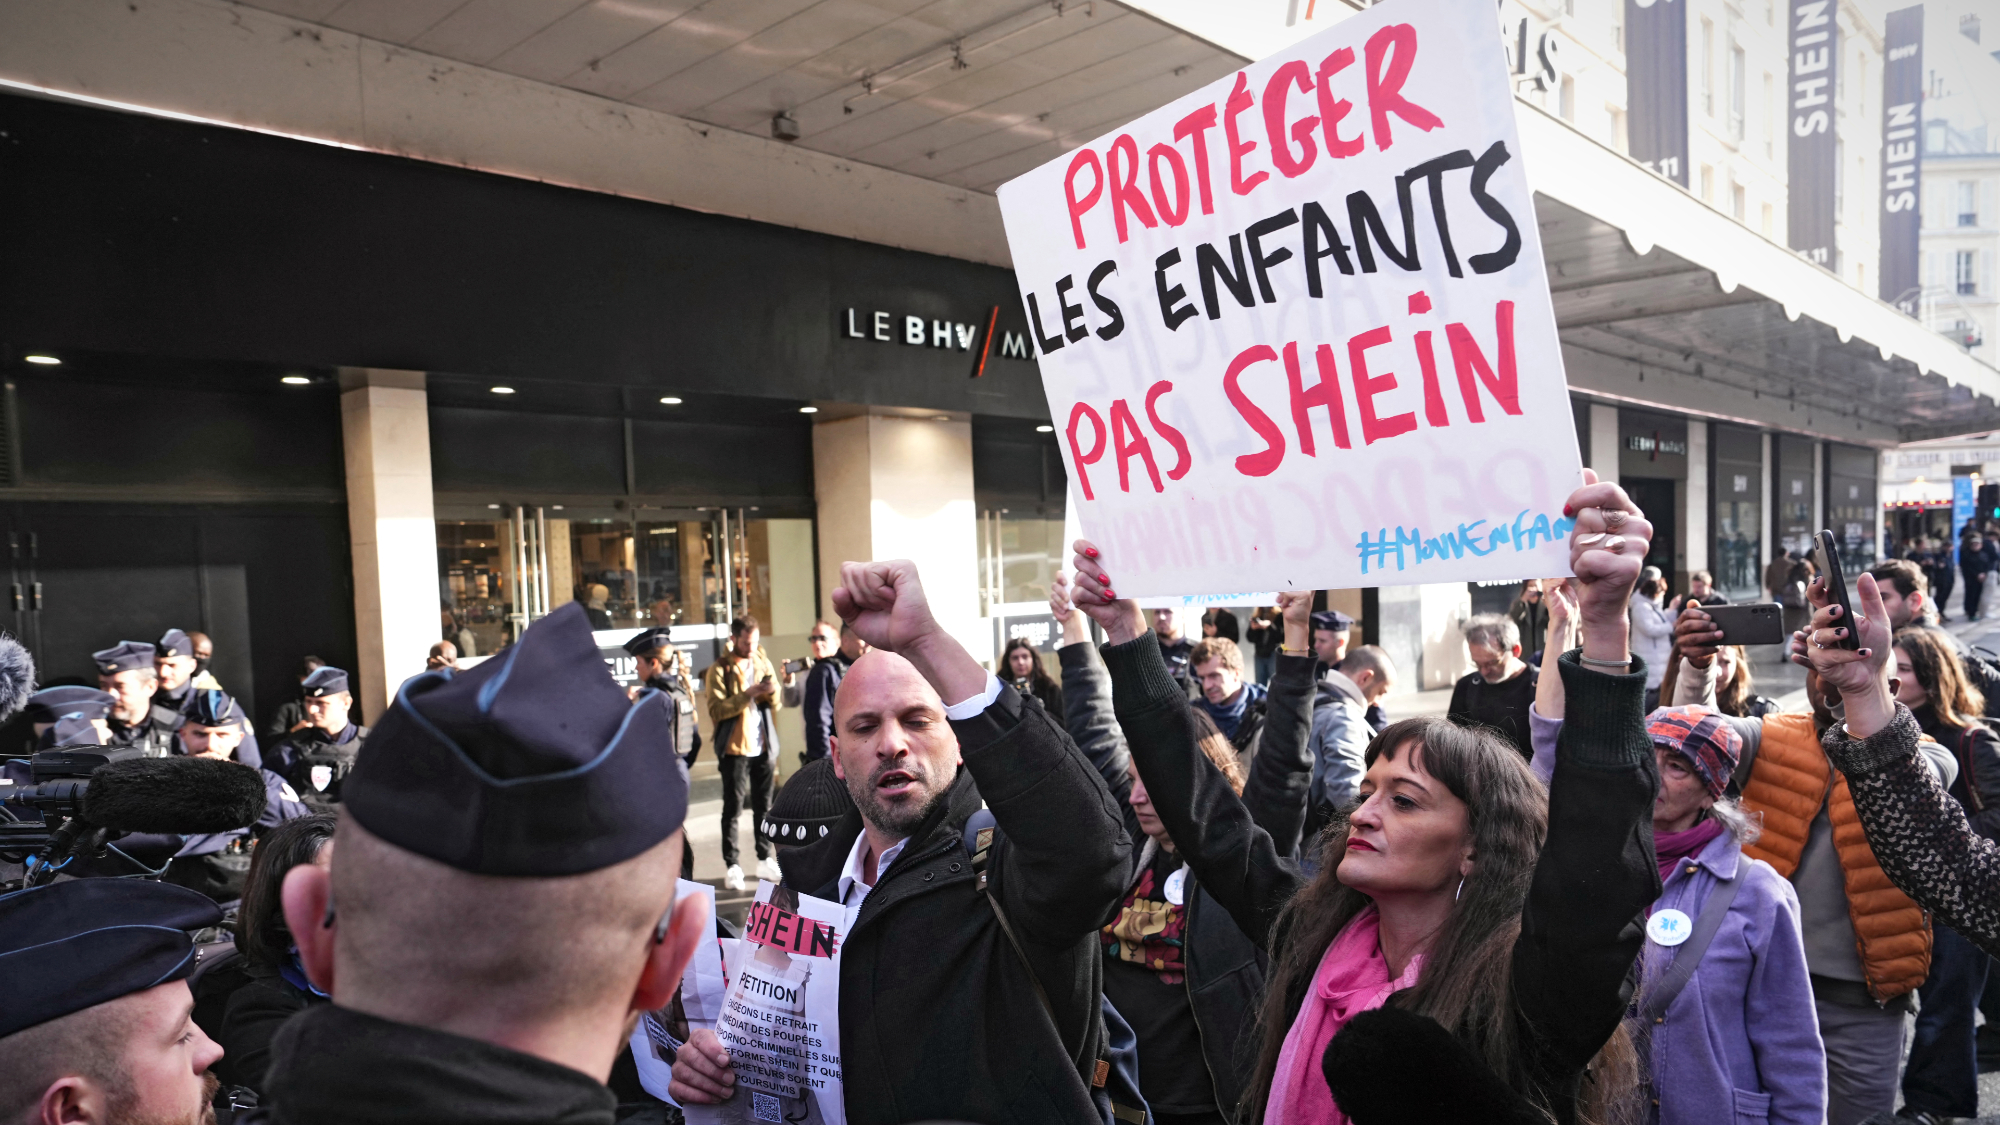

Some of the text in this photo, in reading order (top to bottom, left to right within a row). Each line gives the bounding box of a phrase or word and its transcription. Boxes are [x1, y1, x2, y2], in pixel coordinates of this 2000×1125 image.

[1793, 0, 1830, 138] SHEIN
[1063, 22, 1445, 250] PROTÉGER
[1885, 101, 1917, 213] SHEIN
[1026, 139, 1522, 355] LES ENFANTS
[849, 308, 890, 341] LE
[905, 315, 976, 351] BHV
[1066, 380, 1192, 501] PAS
[747, 900, 836, 960] SHEIN
[739, 971, 797, 1004] PETITION
[751, 1024, 771, 1037] DES
[773, 1029, 822, 1048] POUPÉES
[760, 1011, 773, 1022] LE
[775, 1015, 819, 1033] RETRAIT
[735, 1074, 796, 1095] POURSUIVIS
[768, 1056, 799, 1070] SHEIN
[804, 1064, 817, 1074] ET
[787, 1073, 826, 1089] SOIENT
